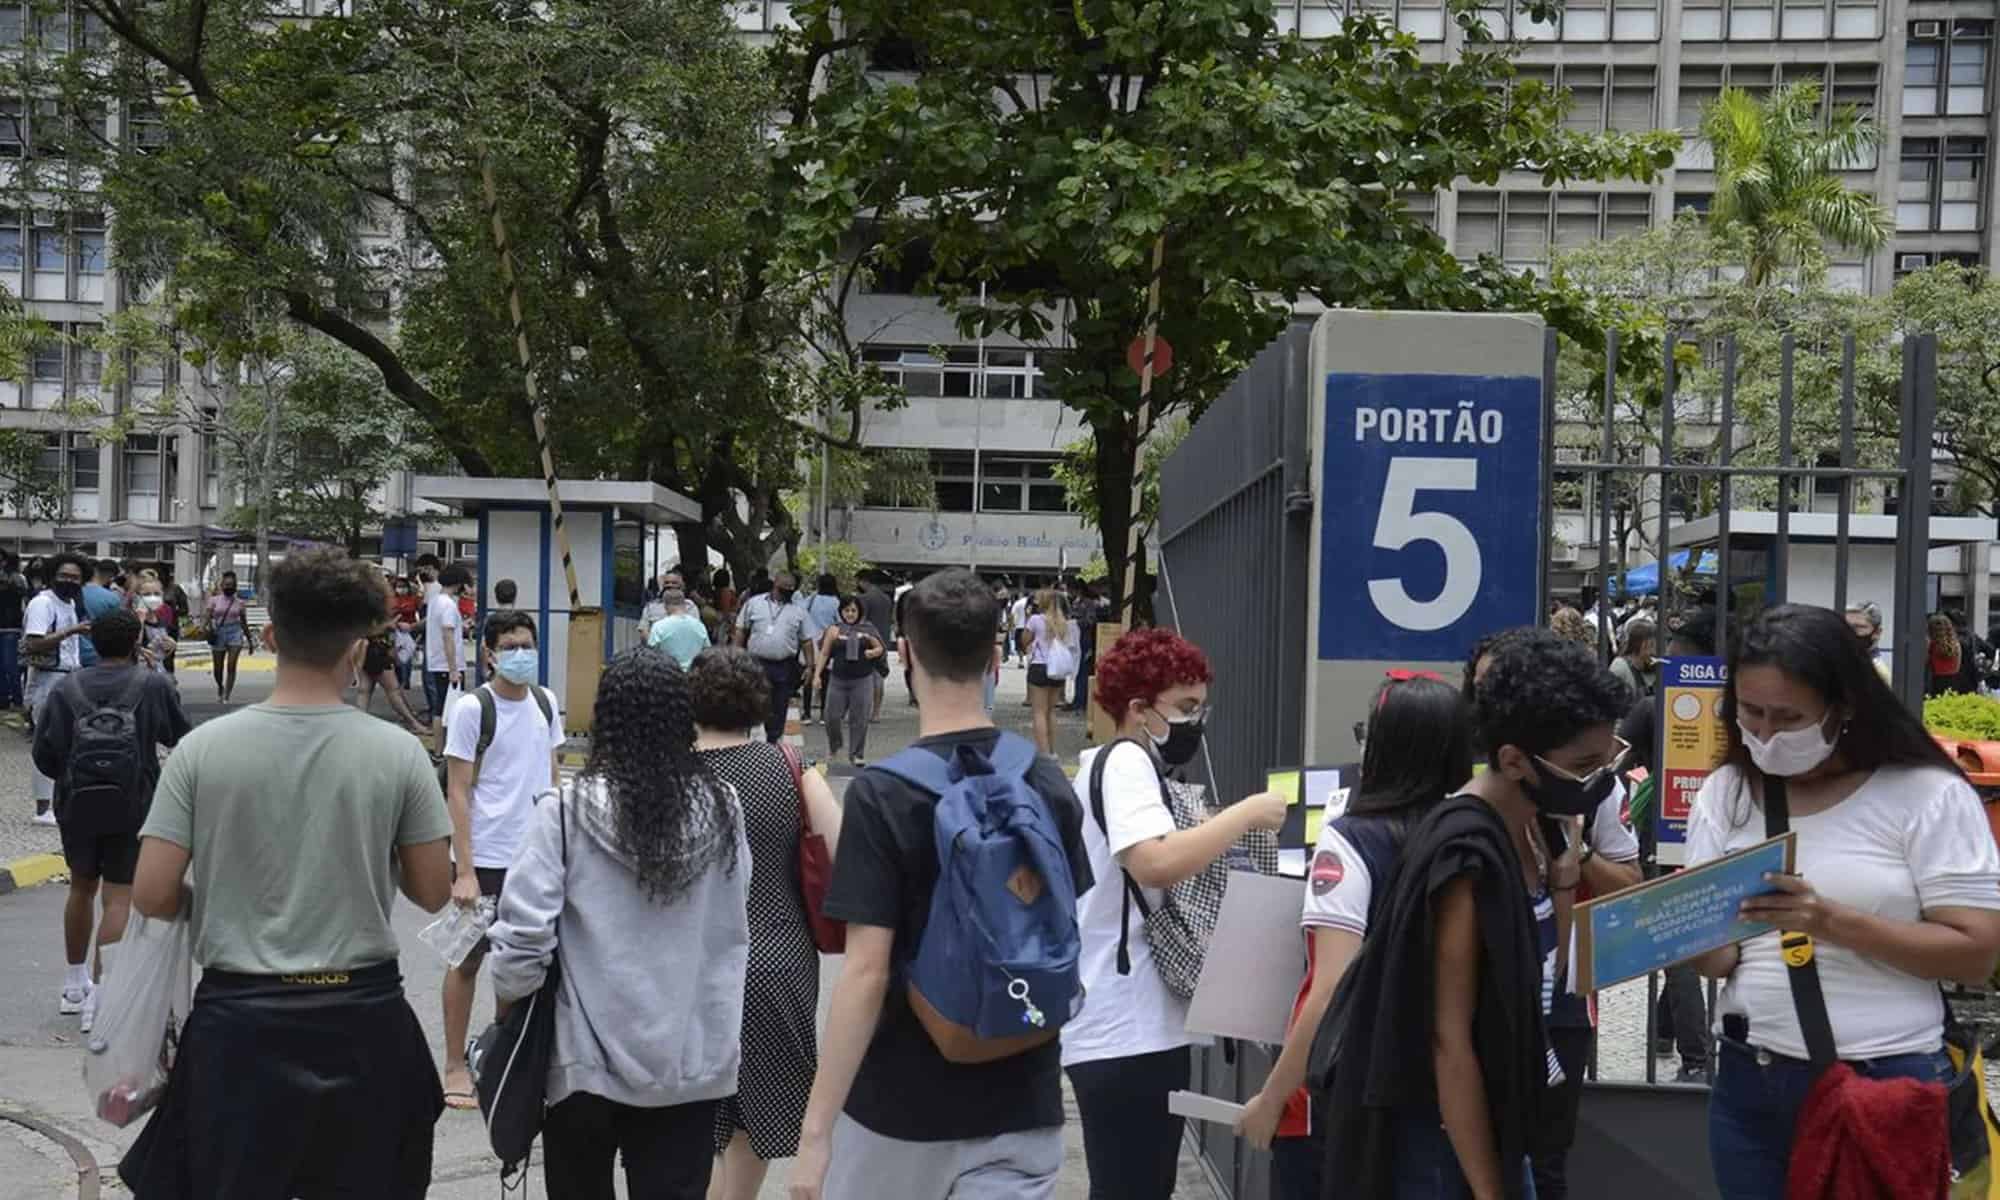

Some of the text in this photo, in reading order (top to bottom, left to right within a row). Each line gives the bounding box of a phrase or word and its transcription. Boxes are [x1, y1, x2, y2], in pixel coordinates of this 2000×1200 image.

[1355, 400, 1503, 443] PORTÃO
[1367, 456, 1482, 631] 5
[1680, 664, 1714, 679] SIGA
